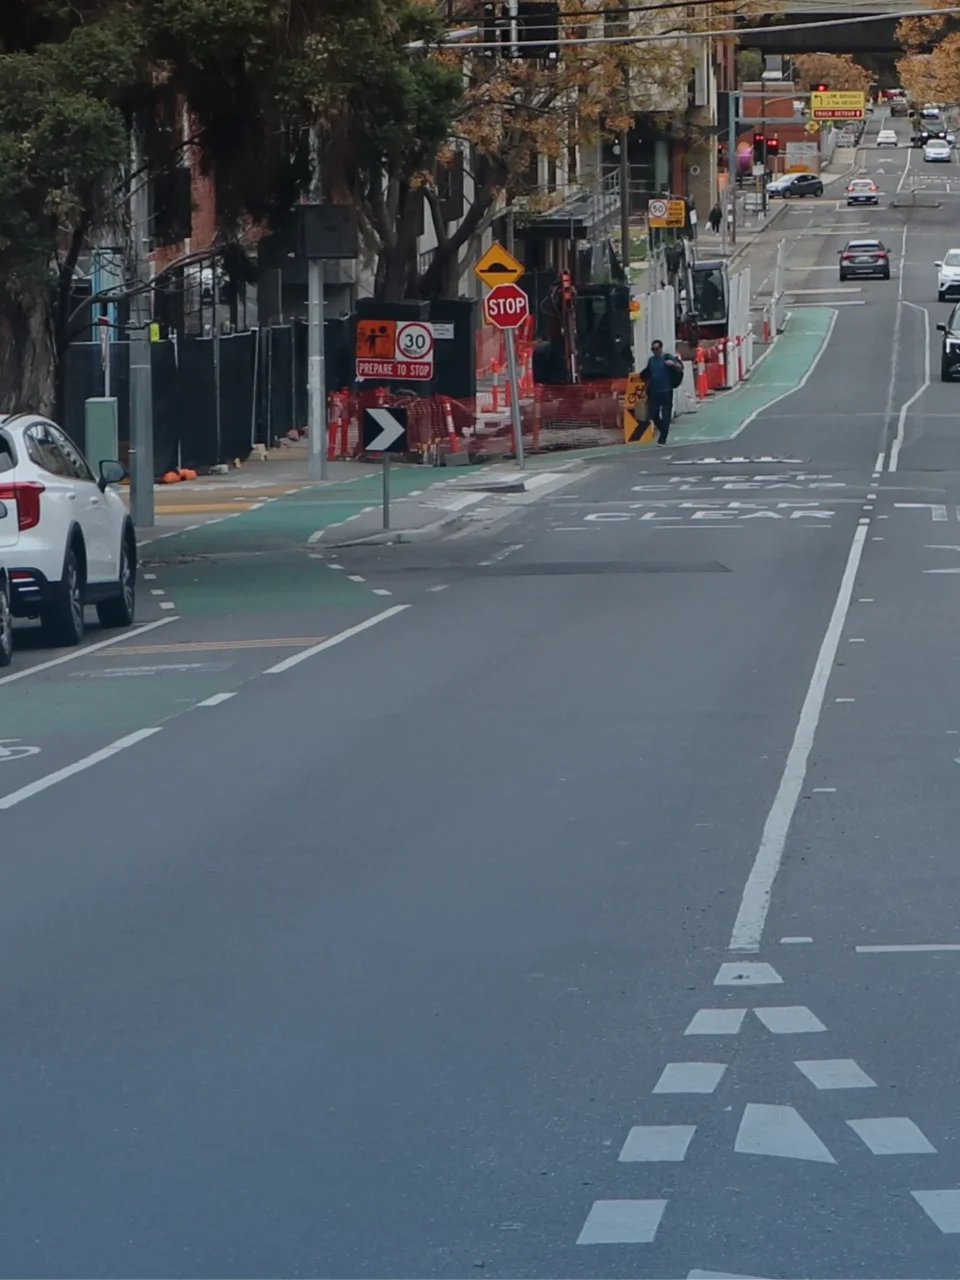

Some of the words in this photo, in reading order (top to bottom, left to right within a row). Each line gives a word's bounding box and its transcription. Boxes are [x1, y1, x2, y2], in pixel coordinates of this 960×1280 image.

[652, 204, 664, 213] 50
[489, 297, 525, 315] STOP
[404, 333, 426, 349] 30
[359, 363, 393, 375] PREPARE
[397, 364, 406, 376] TO
[410, 365, 429, 376] STOP
[668, 475, 833, 483] KEEP
[583, 510, 836, 521] CLEAR
